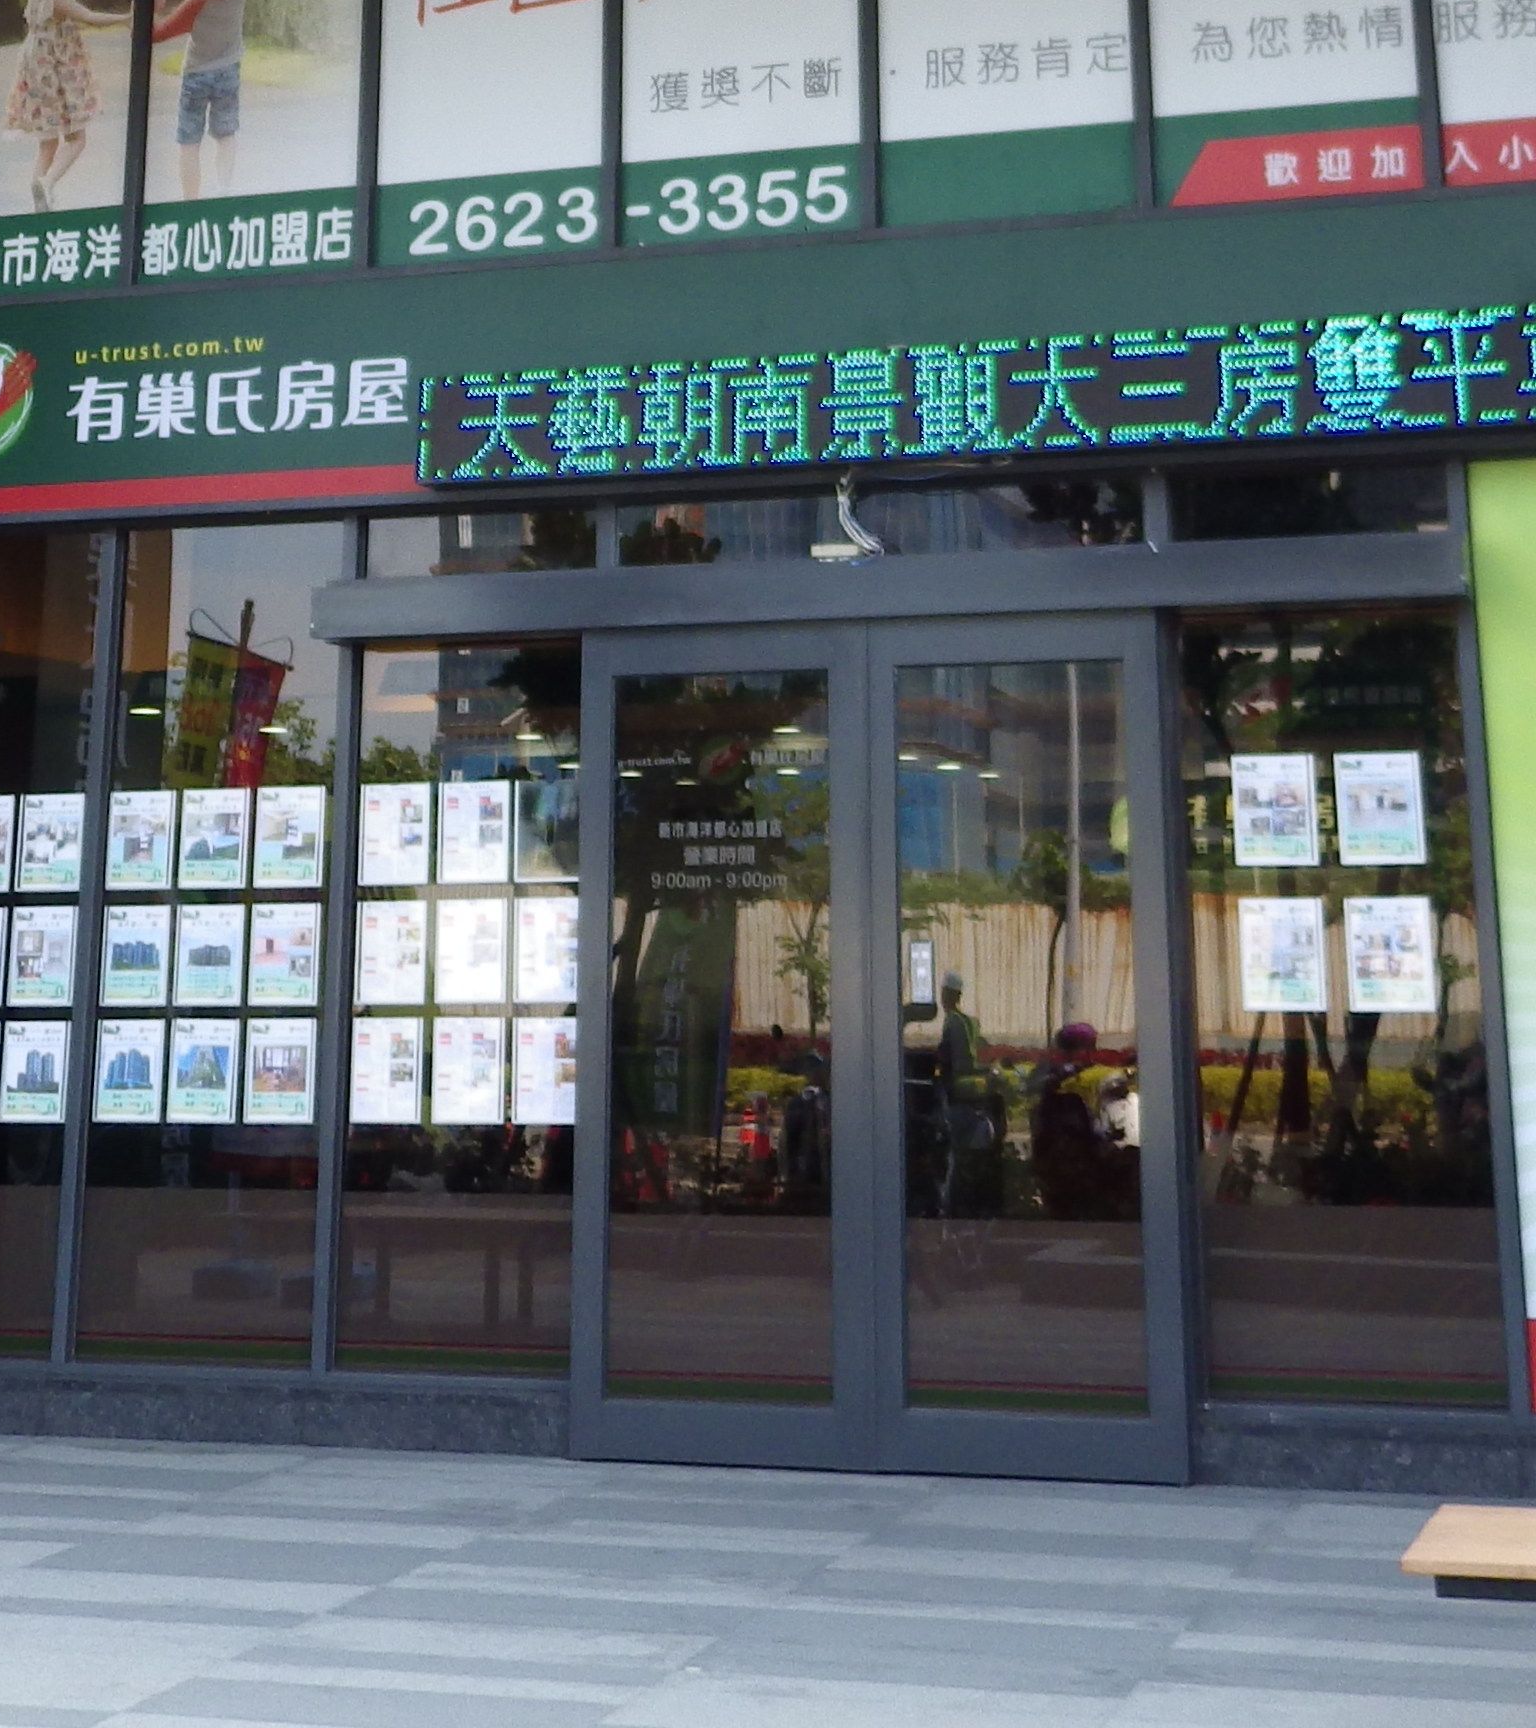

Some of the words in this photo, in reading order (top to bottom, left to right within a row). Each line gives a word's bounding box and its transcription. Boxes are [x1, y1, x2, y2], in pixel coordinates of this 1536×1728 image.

[409, 164, 849, 256] 2623-3355
[74, 333, 264, 365] u-trust.com.tw
[67, 356, 410, 442] 有巢氏房屋
